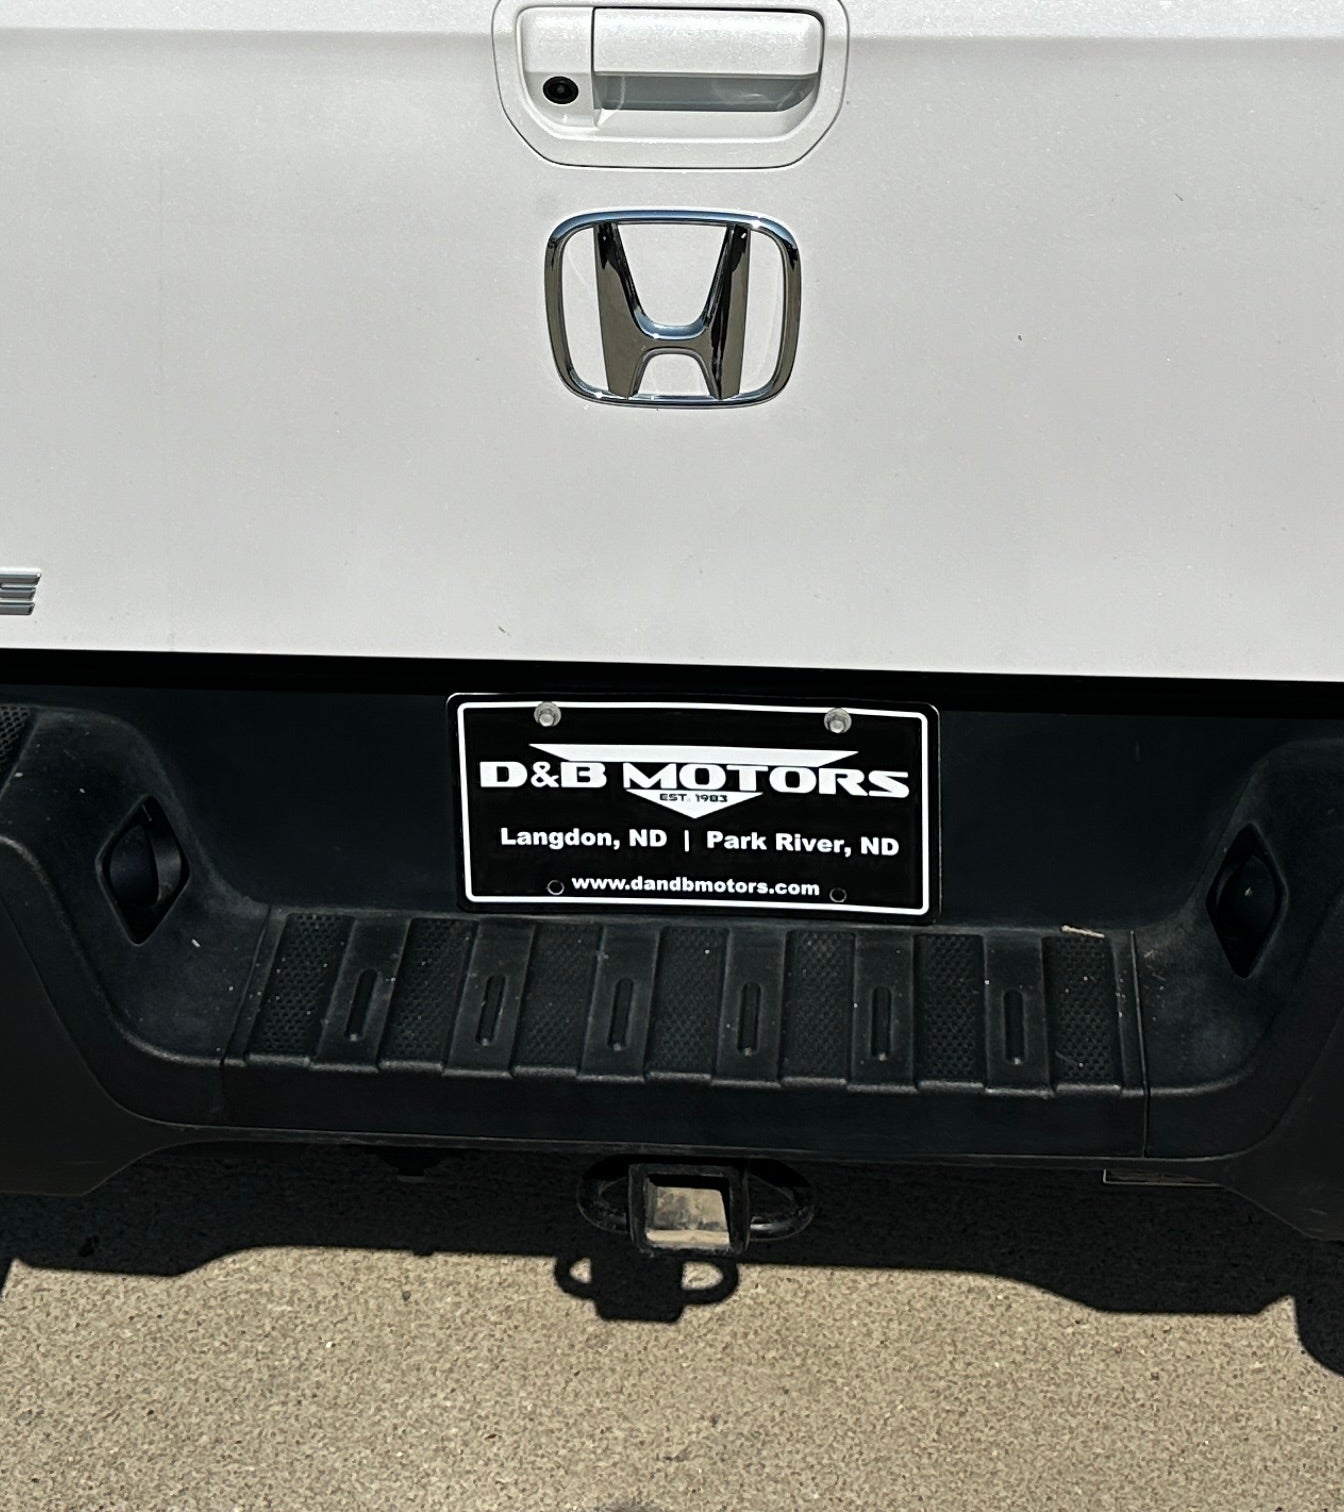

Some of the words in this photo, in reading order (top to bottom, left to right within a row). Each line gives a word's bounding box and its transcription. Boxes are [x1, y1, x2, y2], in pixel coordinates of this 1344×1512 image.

[479, 760, 607, 789] D&B
[622, 761, 911, 799] MOTORS
[500, 827, 621, 851] Langdon,
[628, 828, 668, 848] ND
[706, 830, 768, 851] Park
[775, 832, 853, 858] River,
[860, 836, 900, 857] ND
[571, 874, 821, 898] www.dandbmotors.com
